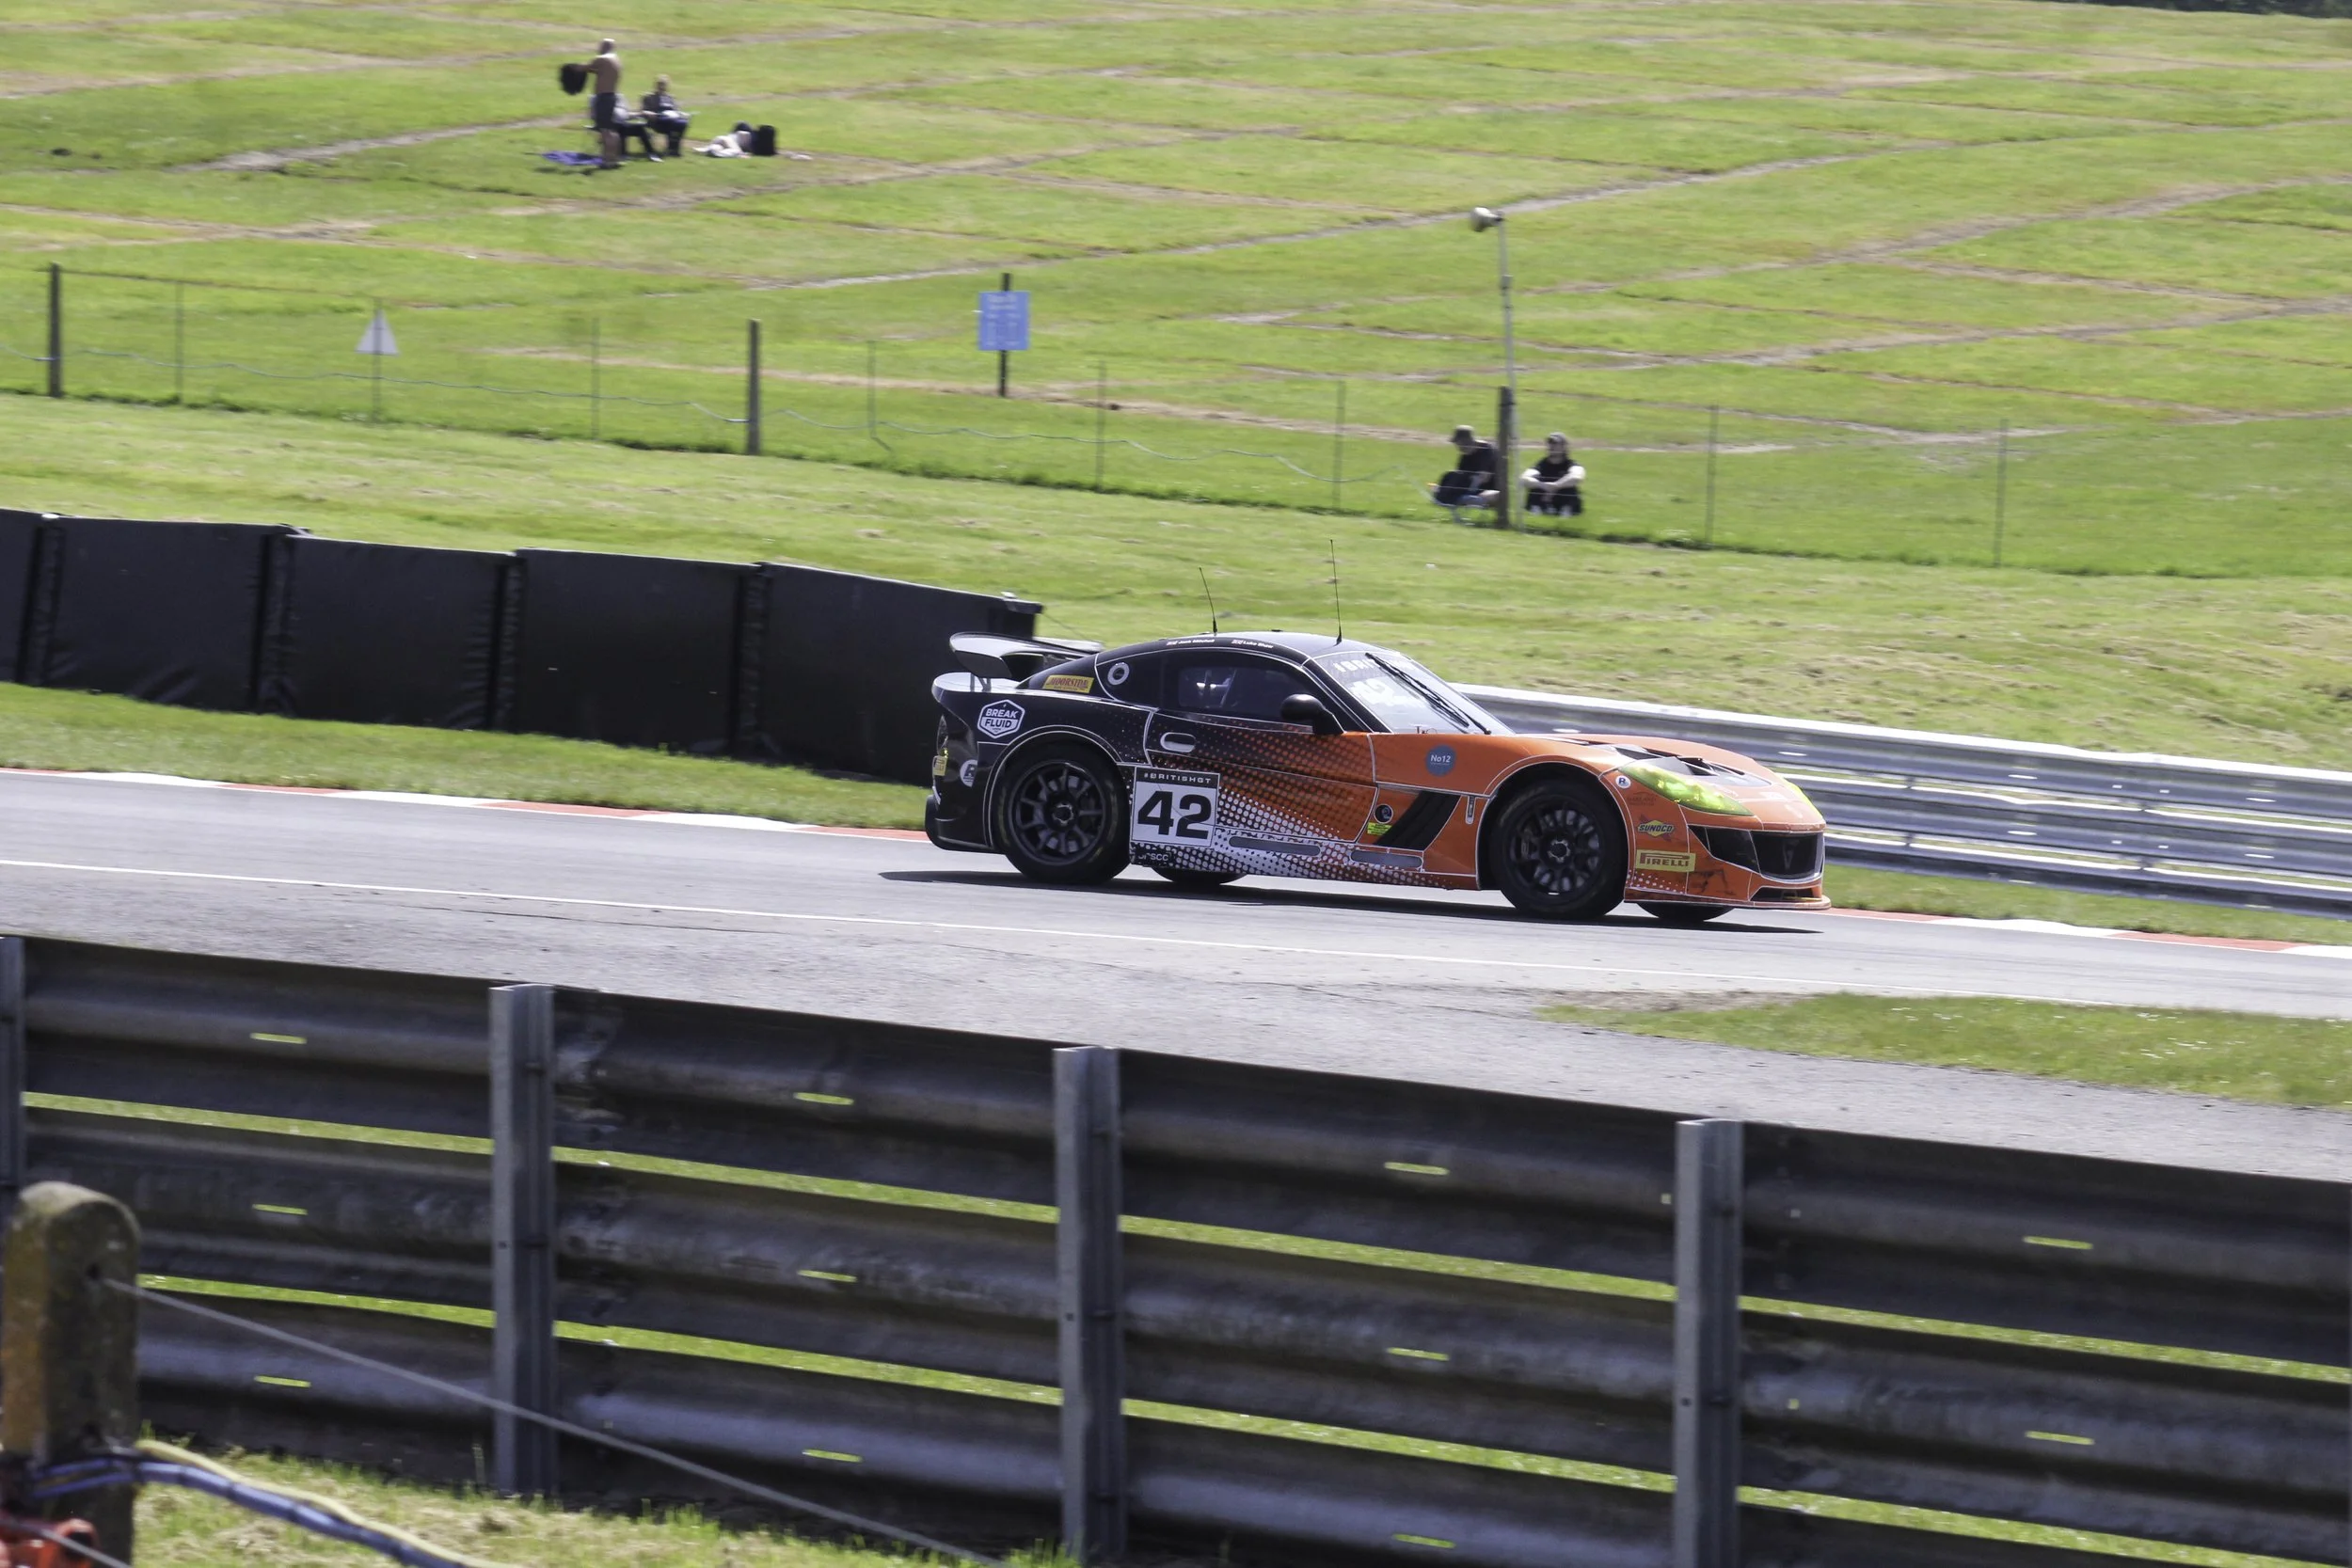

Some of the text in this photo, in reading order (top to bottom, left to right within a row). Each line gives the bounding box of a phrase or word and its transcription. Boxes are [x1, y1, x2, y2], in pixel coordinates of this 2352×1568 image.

[985, 708, 1019, 719] BREAK
[984, 719, 1012, 728] FLUID
[1430, 754, 1452, 763] No12
[1143, 772, 1212, 784] #BRITISHGT
[1137, 790, 1212, 840] 42
[1639, 824, 1674, 832] SUNOCO
[1639, 852, 1691, 867] PIRELLI
